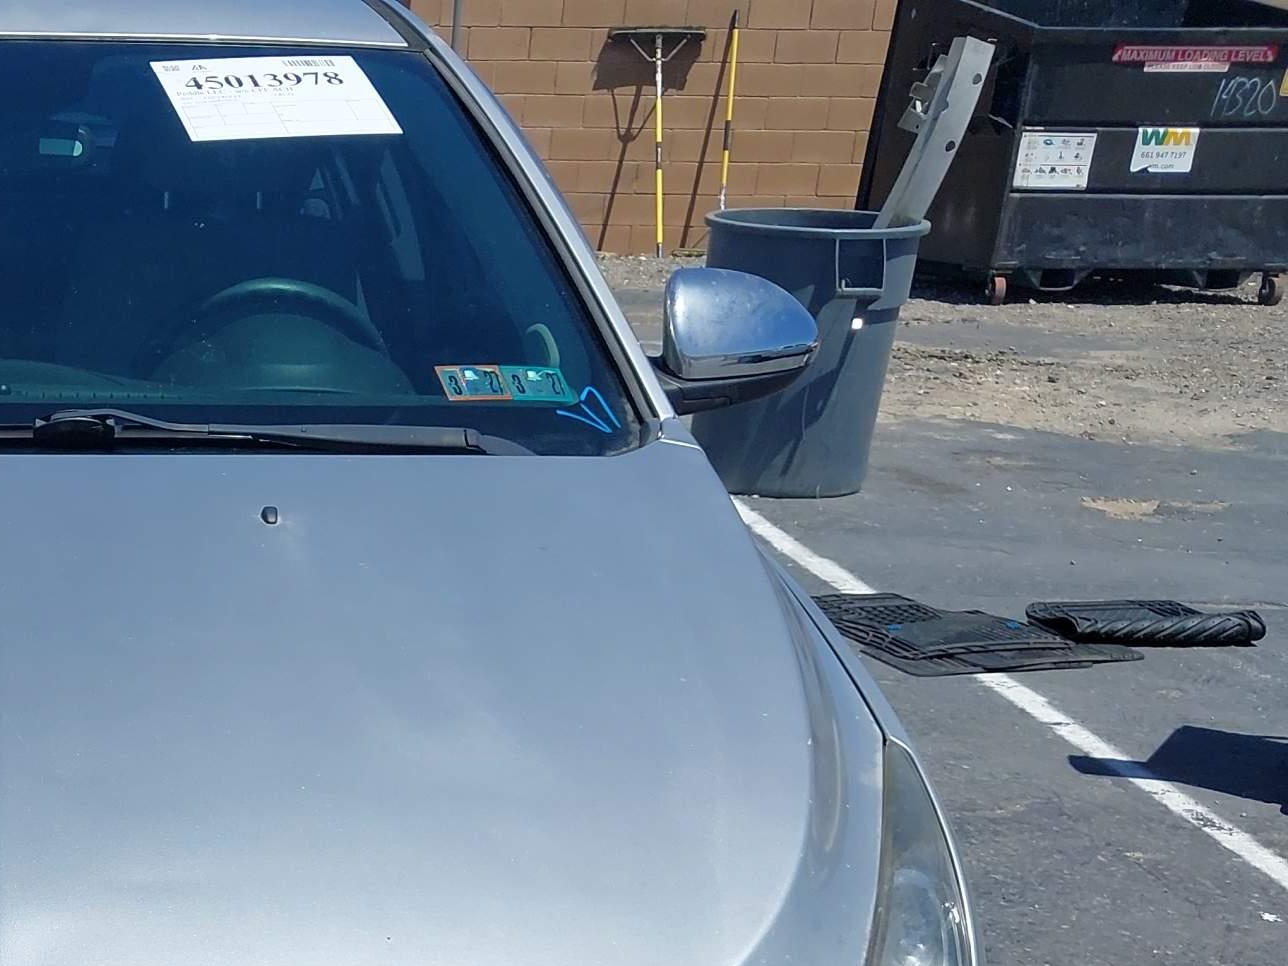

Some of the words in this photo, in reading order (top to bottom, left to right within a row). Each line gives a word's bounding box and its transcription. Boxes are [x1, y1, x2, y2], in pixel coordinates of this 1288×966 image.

[1121, 50, 1176, 61] MAXIMUM
[1177, 50, 1228, 61] LOADING
[1230, 50, 1266, 61] LEVEL
[185, 72, 344, 90] 45013978
[1141, 128, 1192, 146] WM
[1140, 151, 1153, 159] 661
[1155, 151, 1169, 159] 947
[1170, 151, 1187, 159] 7197
[448, 375, 463, 396] 3
[511, 374, 526, 394] 3
